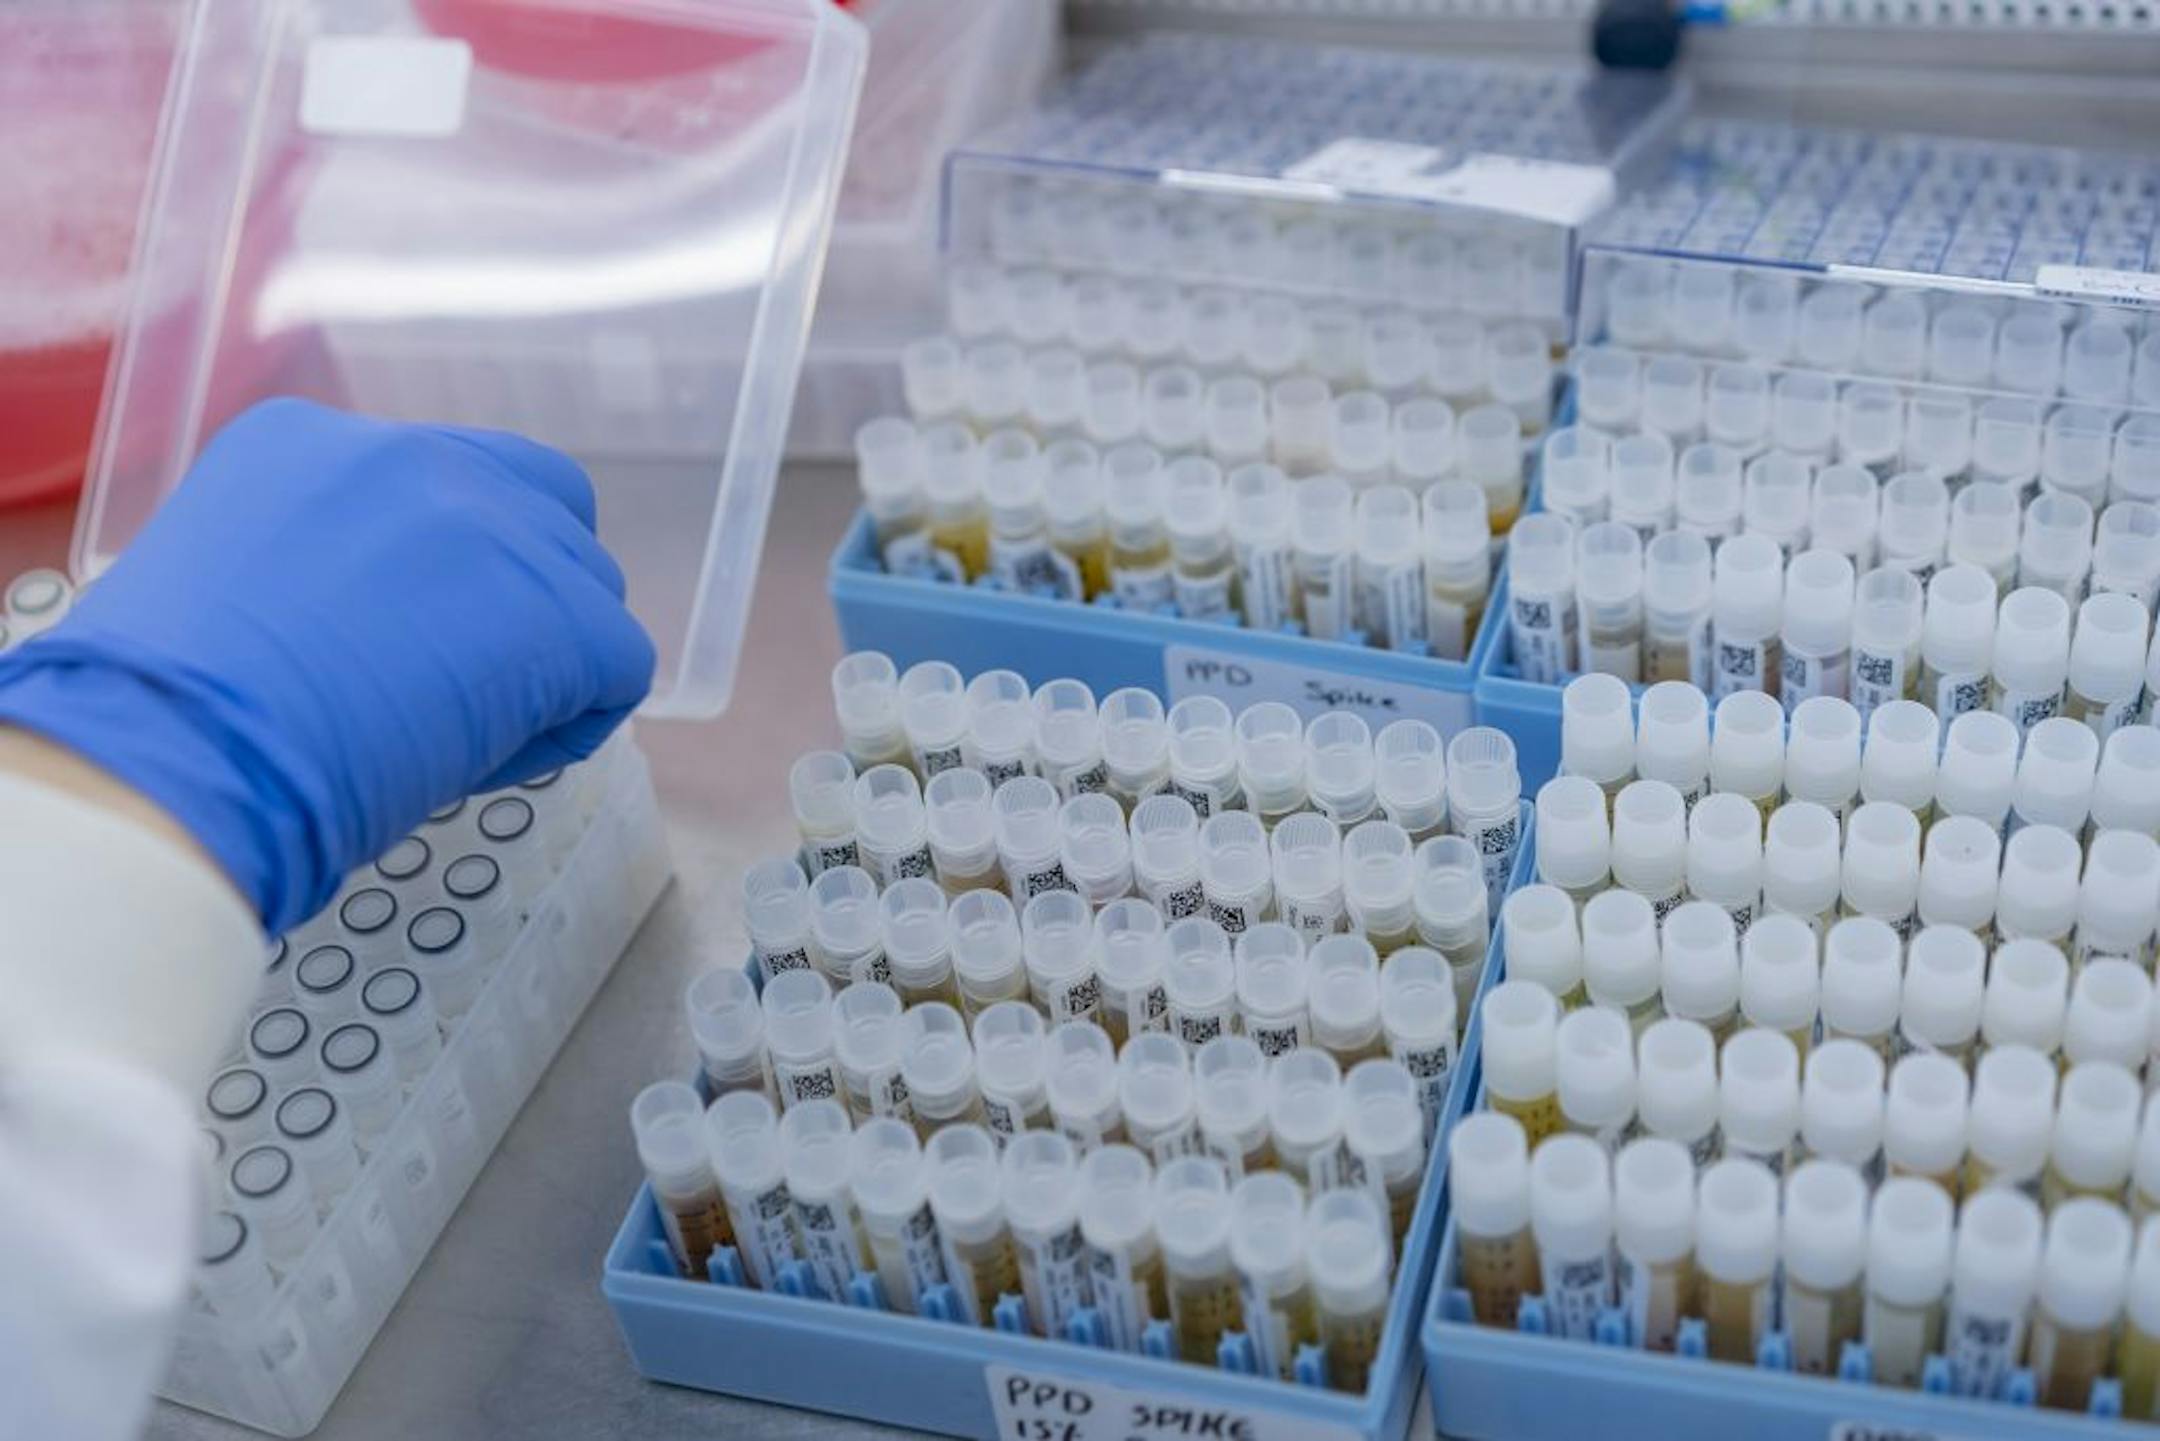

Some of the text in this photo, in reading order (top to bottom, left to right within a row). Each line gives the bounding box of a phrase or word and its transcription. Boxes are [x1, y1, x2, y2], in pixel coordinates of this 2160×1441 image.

[1186, 661, 1252, 687] PPD
[1006, 1376, 1254, 1441] PPD SPIKE
